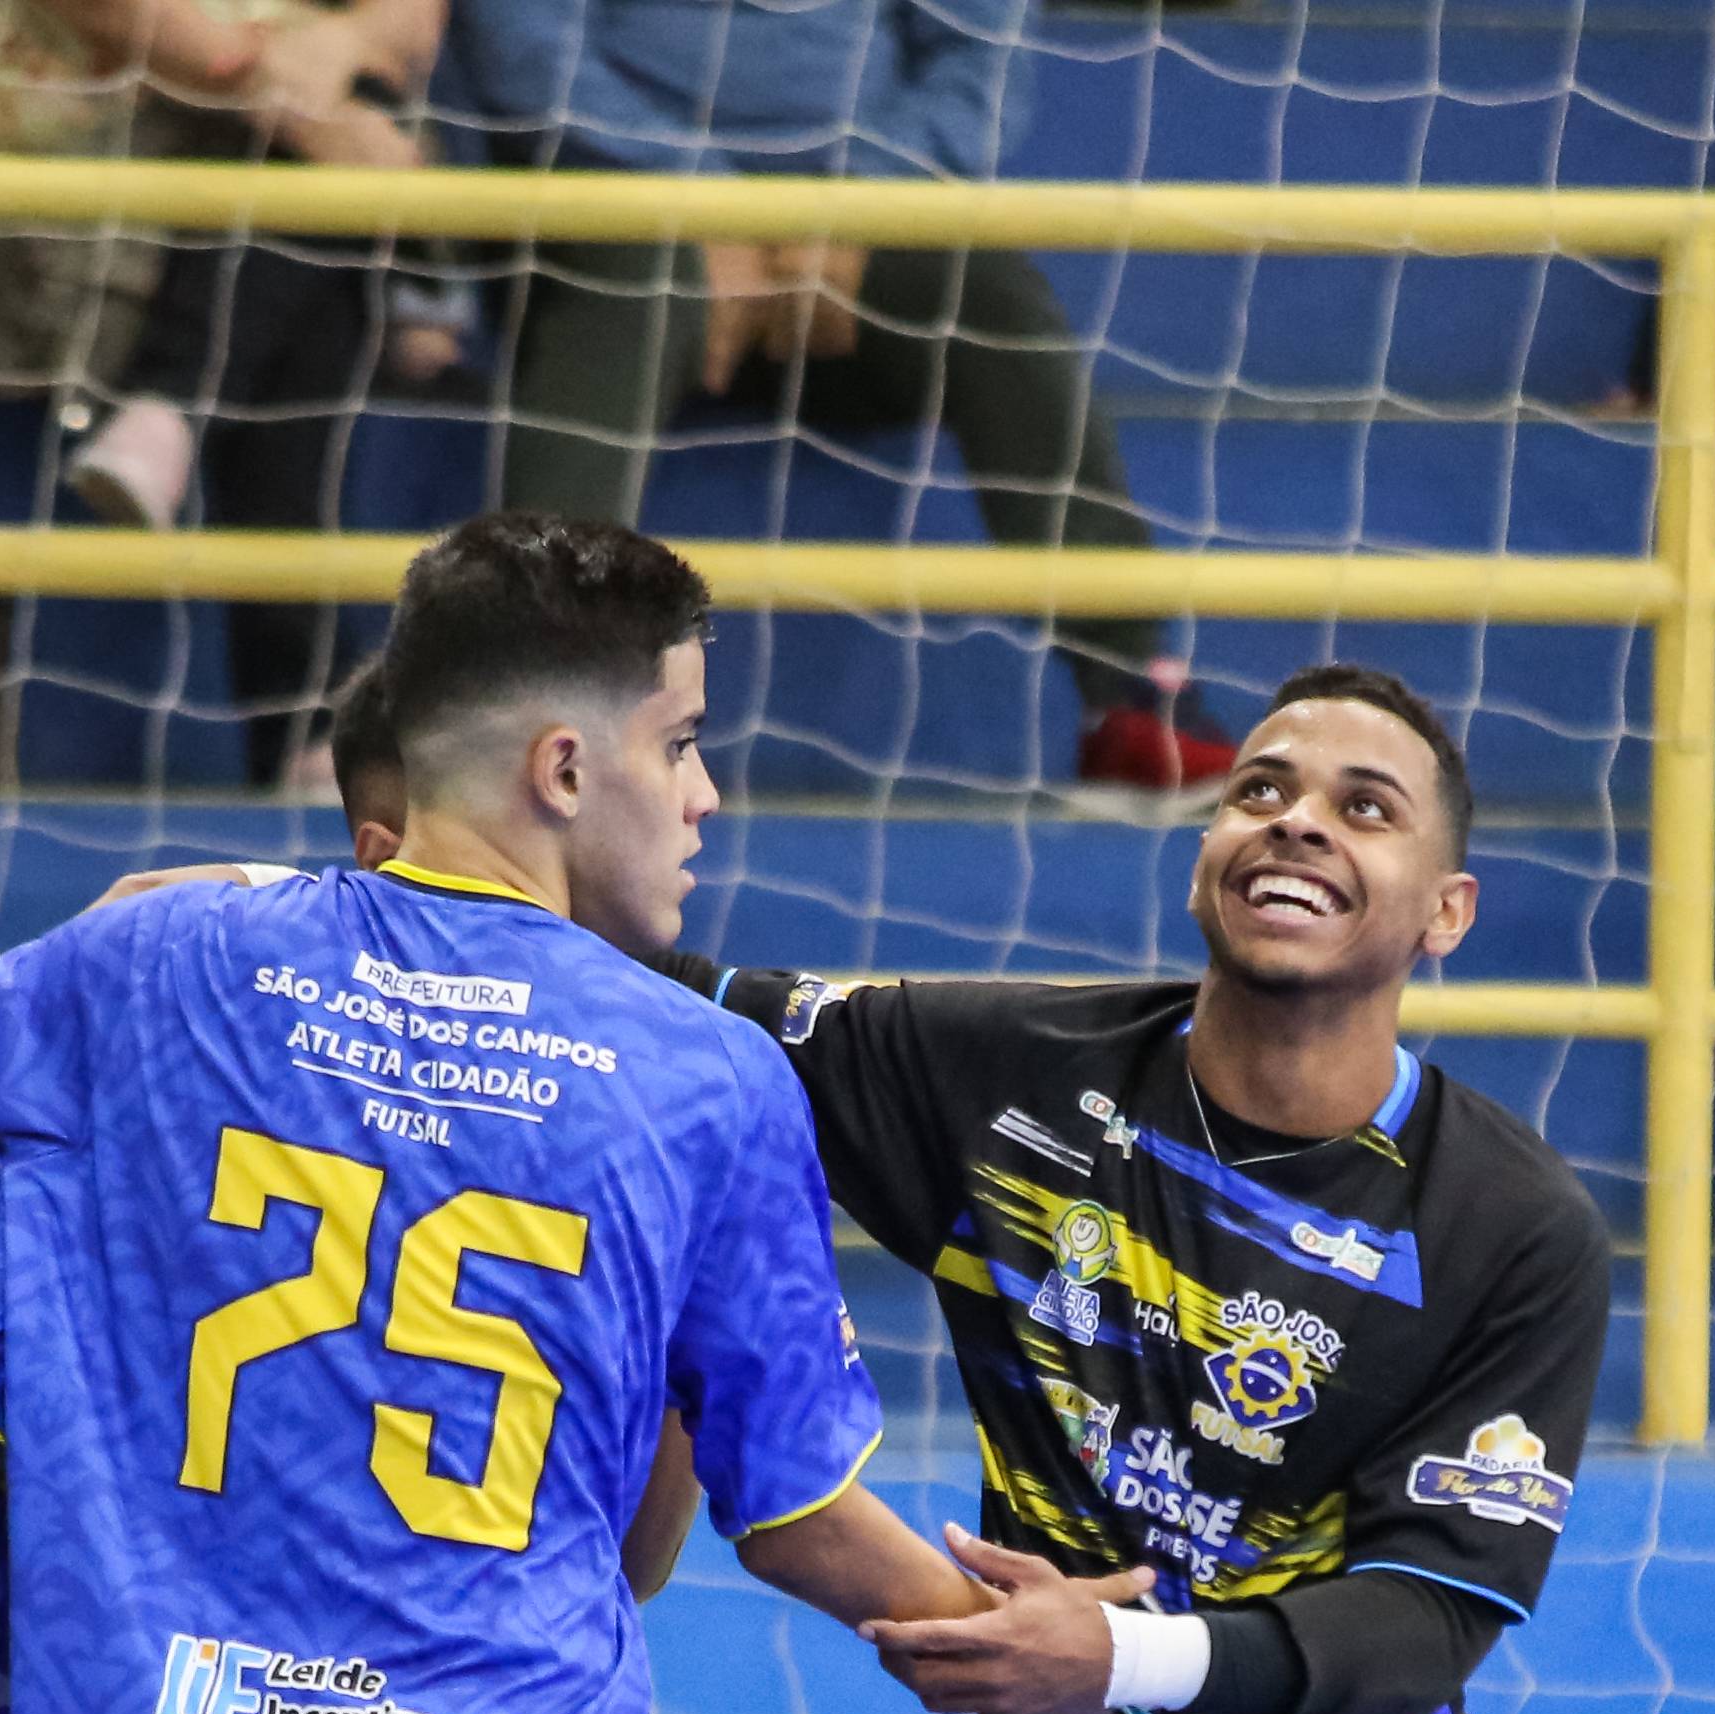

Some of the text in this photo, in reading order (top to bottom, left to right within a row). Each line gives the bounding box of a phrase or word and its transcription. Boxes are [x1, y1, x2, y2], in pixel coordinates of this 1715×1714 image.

[368, 966, 515, 1008] PREFEITURA
[254, 966, 618, 1074] SÃO JOSÉ DOS CAMPOS
[287, 1023, 561, 1107] ATLETA CIDADÃO
[362, 1099, 451, 1148] FUTSAL
[1223, 1291, 1284, 1328] SÃO
[178, 1126, 588, 1552] 75
[1115, 1475, 1182, 1525] DOS
[270, 1656, 382, 1696] Lei de
